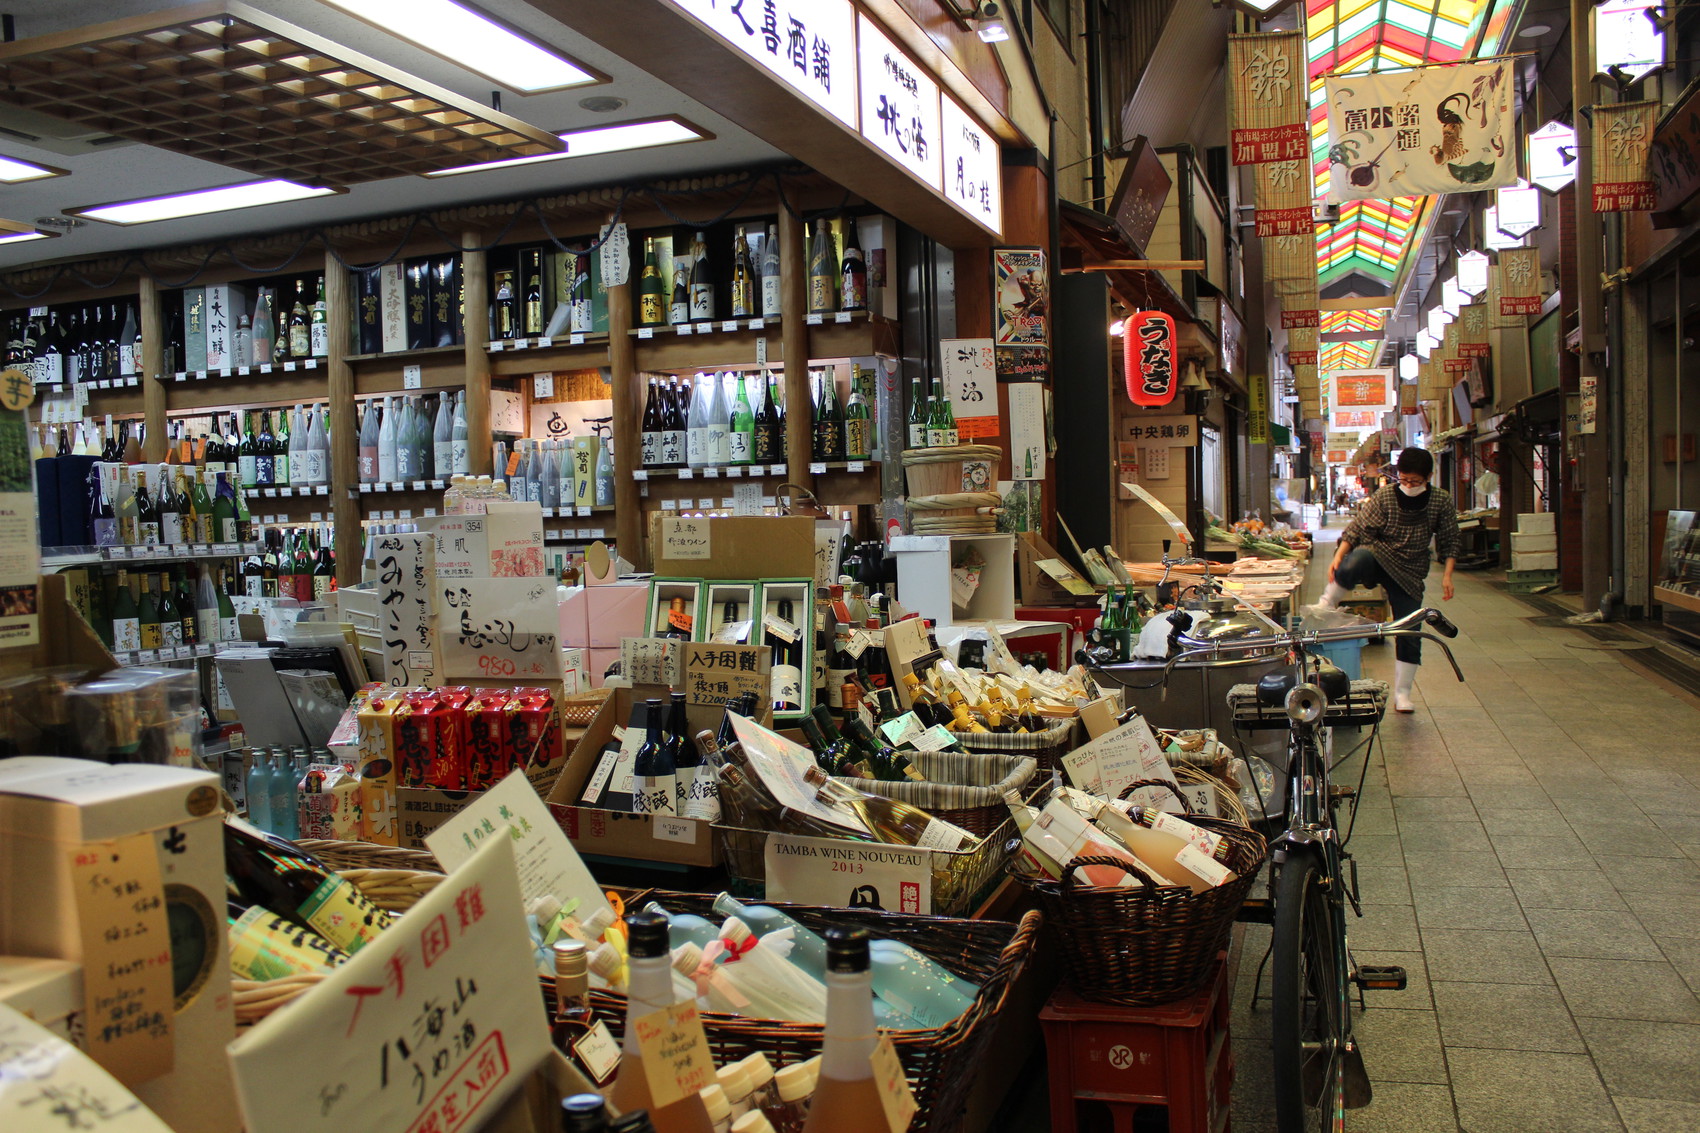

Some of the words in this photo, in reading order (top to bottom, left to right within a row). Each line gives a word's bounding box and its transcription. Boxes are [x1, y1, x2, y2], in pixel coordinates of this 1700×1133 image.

[1345, 104, 1420, 131] 富小路
[1234, 125, 1305, 144] 錦市場ポイントカード
[1397, 129, 1421, 152] 通
[1235, 138, 1306, 164] 加盟店
[955, 155, 992, 214] 月の桂
[1595, 195, 1655, 211] 加盟店
[1257, 217, 1313, 238] 加盟店
[814, 279, 826, 308] 玉乃光
[1140, 317, 1171, 395] うなぎ
[1129, 424, 1190, 439] 中央鶏卵
[576, 451, 590, 474] 松の司
[466, 521, 481, 531] 354
[478, 654, 517, 676] 980
[688, 650, 758, 673] 入手困難
[309, 795, 322, 839] 菊正宗
[774, 843, 818, 858] TAMBA
[820, 847, 856, 861] WINE
[858, 851, 923, 866] NOUVEAU
[831, 860, 865, 875] 2013
[345, 882, 486, 1039] 入手困難
[379, 976, 478, 1090] 八海山
